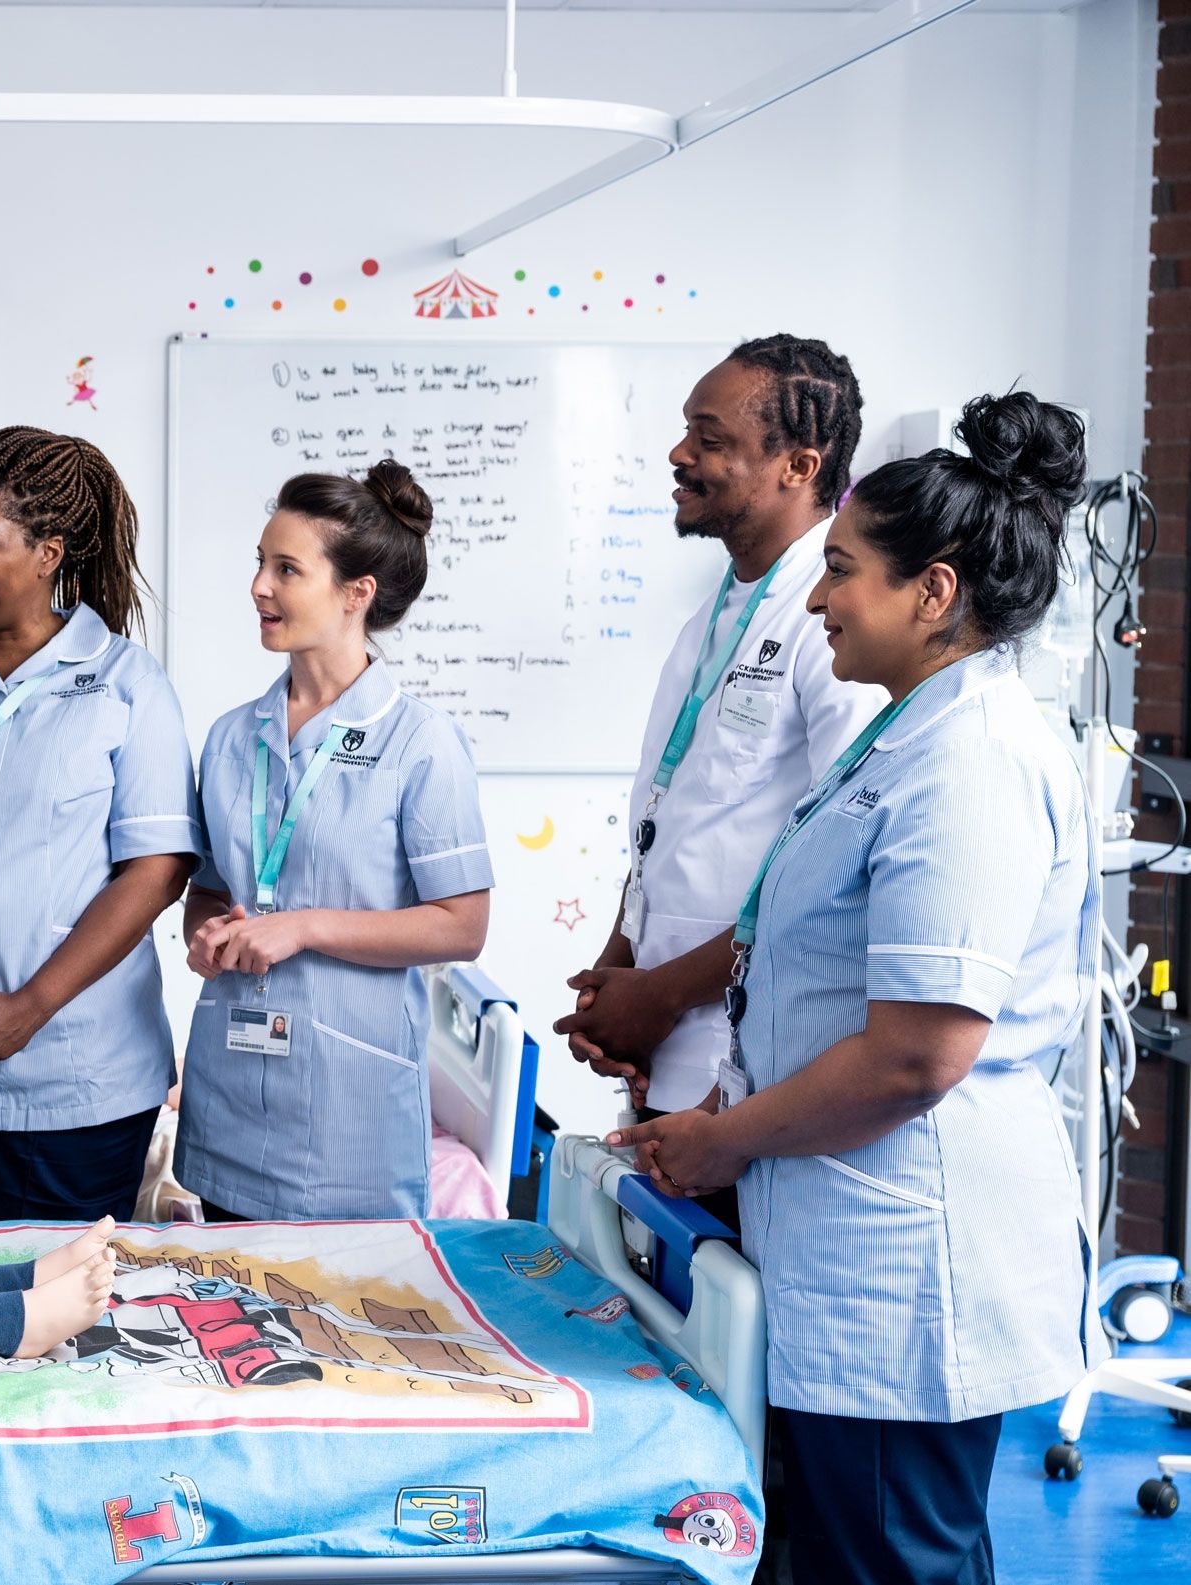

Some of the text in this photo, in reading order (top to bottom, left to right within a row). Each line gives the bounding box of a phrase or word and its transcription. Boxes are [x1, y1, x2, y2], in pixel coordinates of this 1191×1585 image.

[352, 360, 378, 381] baby
[414, 366, 425, 376] or
[432, 364, 458, 376] bottle
[296, 390, 320, 401] How
[333, 386, 358, 397] much
[420, 380, 442, 391] does
[476, 379, 500, 395] baby
[297, 429, 322, 442] How
[382, 424, 396, 439] do
[413, 428, 432, 443] you
[491, 439, 515, 449] How
[565, 594, 574, 611] A
[561, 624, 575, 646] G
[737, 672, 752, 680] NEW
[337, 758, 370, 767] UNIVERSITY
[859, 786, 881, 803] bucks
[109, 1502, 128, 1560] THOMAS
